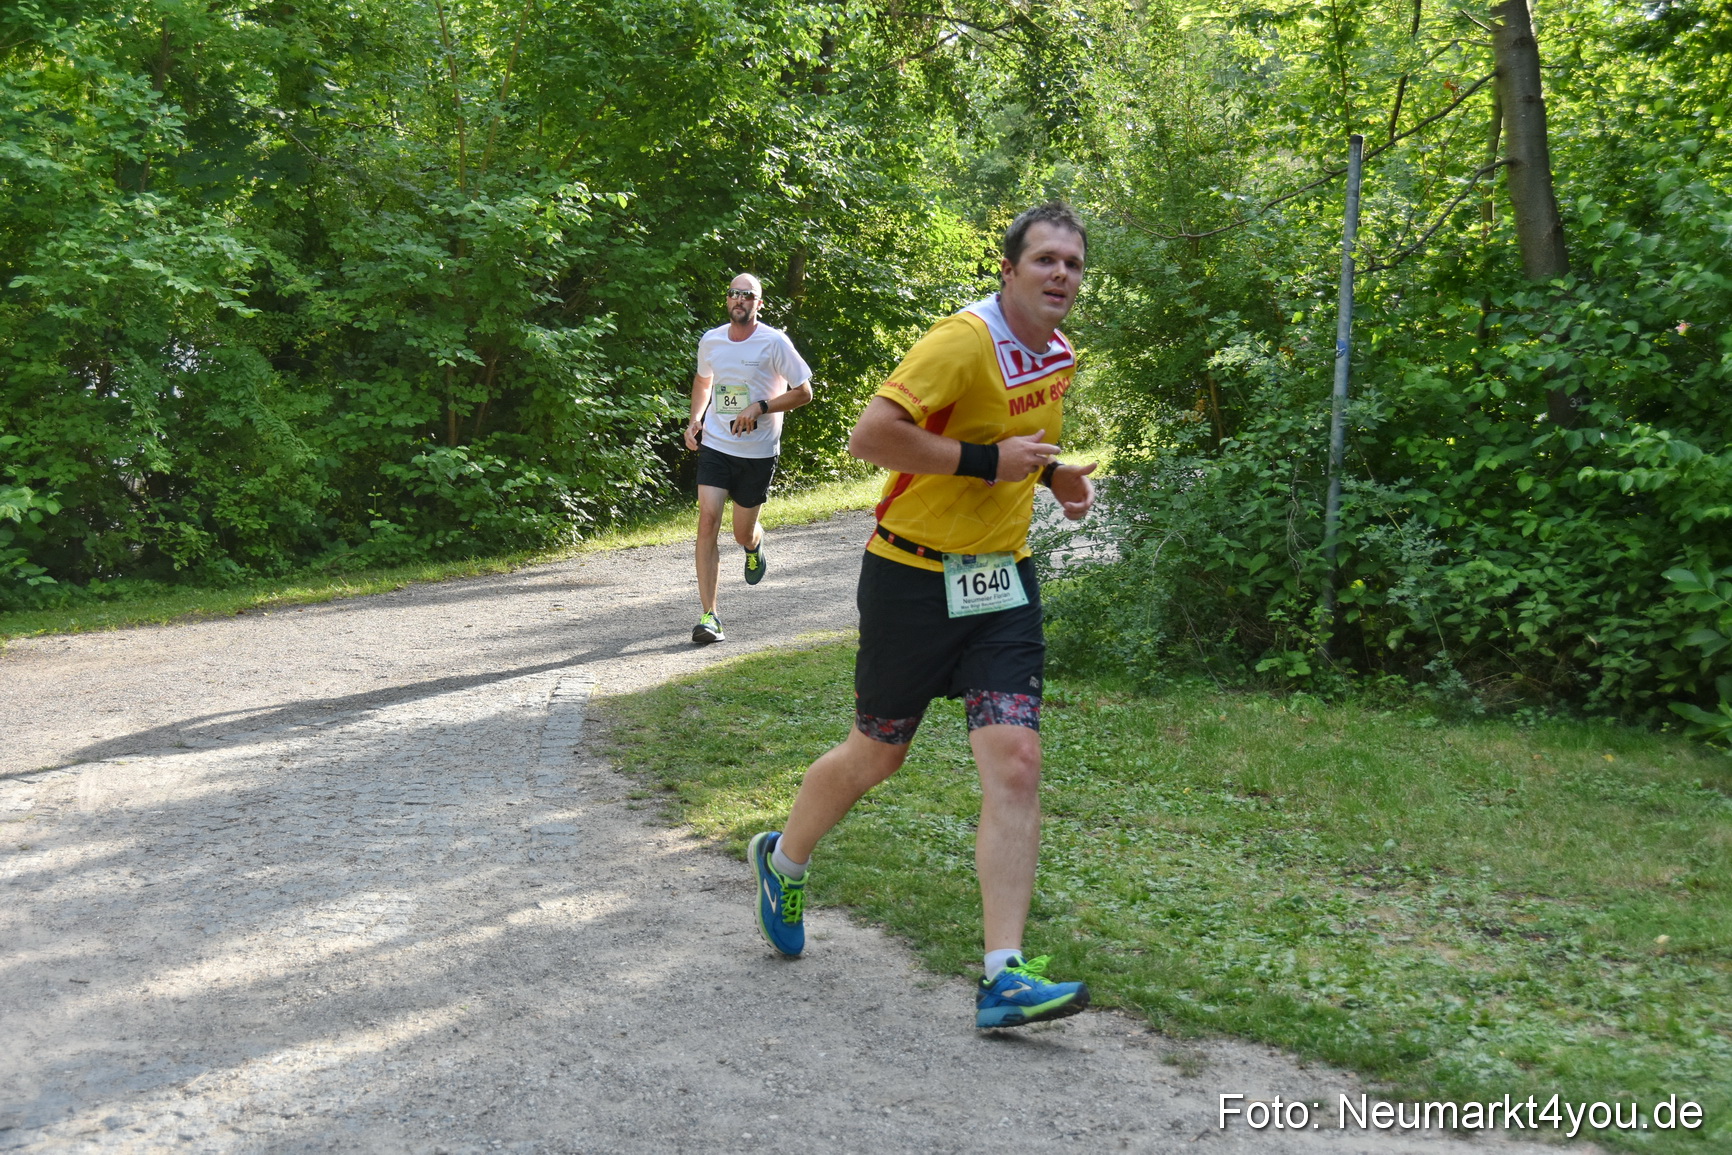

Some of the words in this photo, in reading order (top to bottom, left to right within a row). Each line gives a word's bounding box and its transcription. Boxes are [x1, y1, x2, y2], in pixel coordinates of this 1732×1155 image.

[724, 395, 737, 406] 84
[1008, 388, 1046, 417] MAX
[957, 568, 1010, 597] 1640
[962, 595, 992, 604] Neumeier
